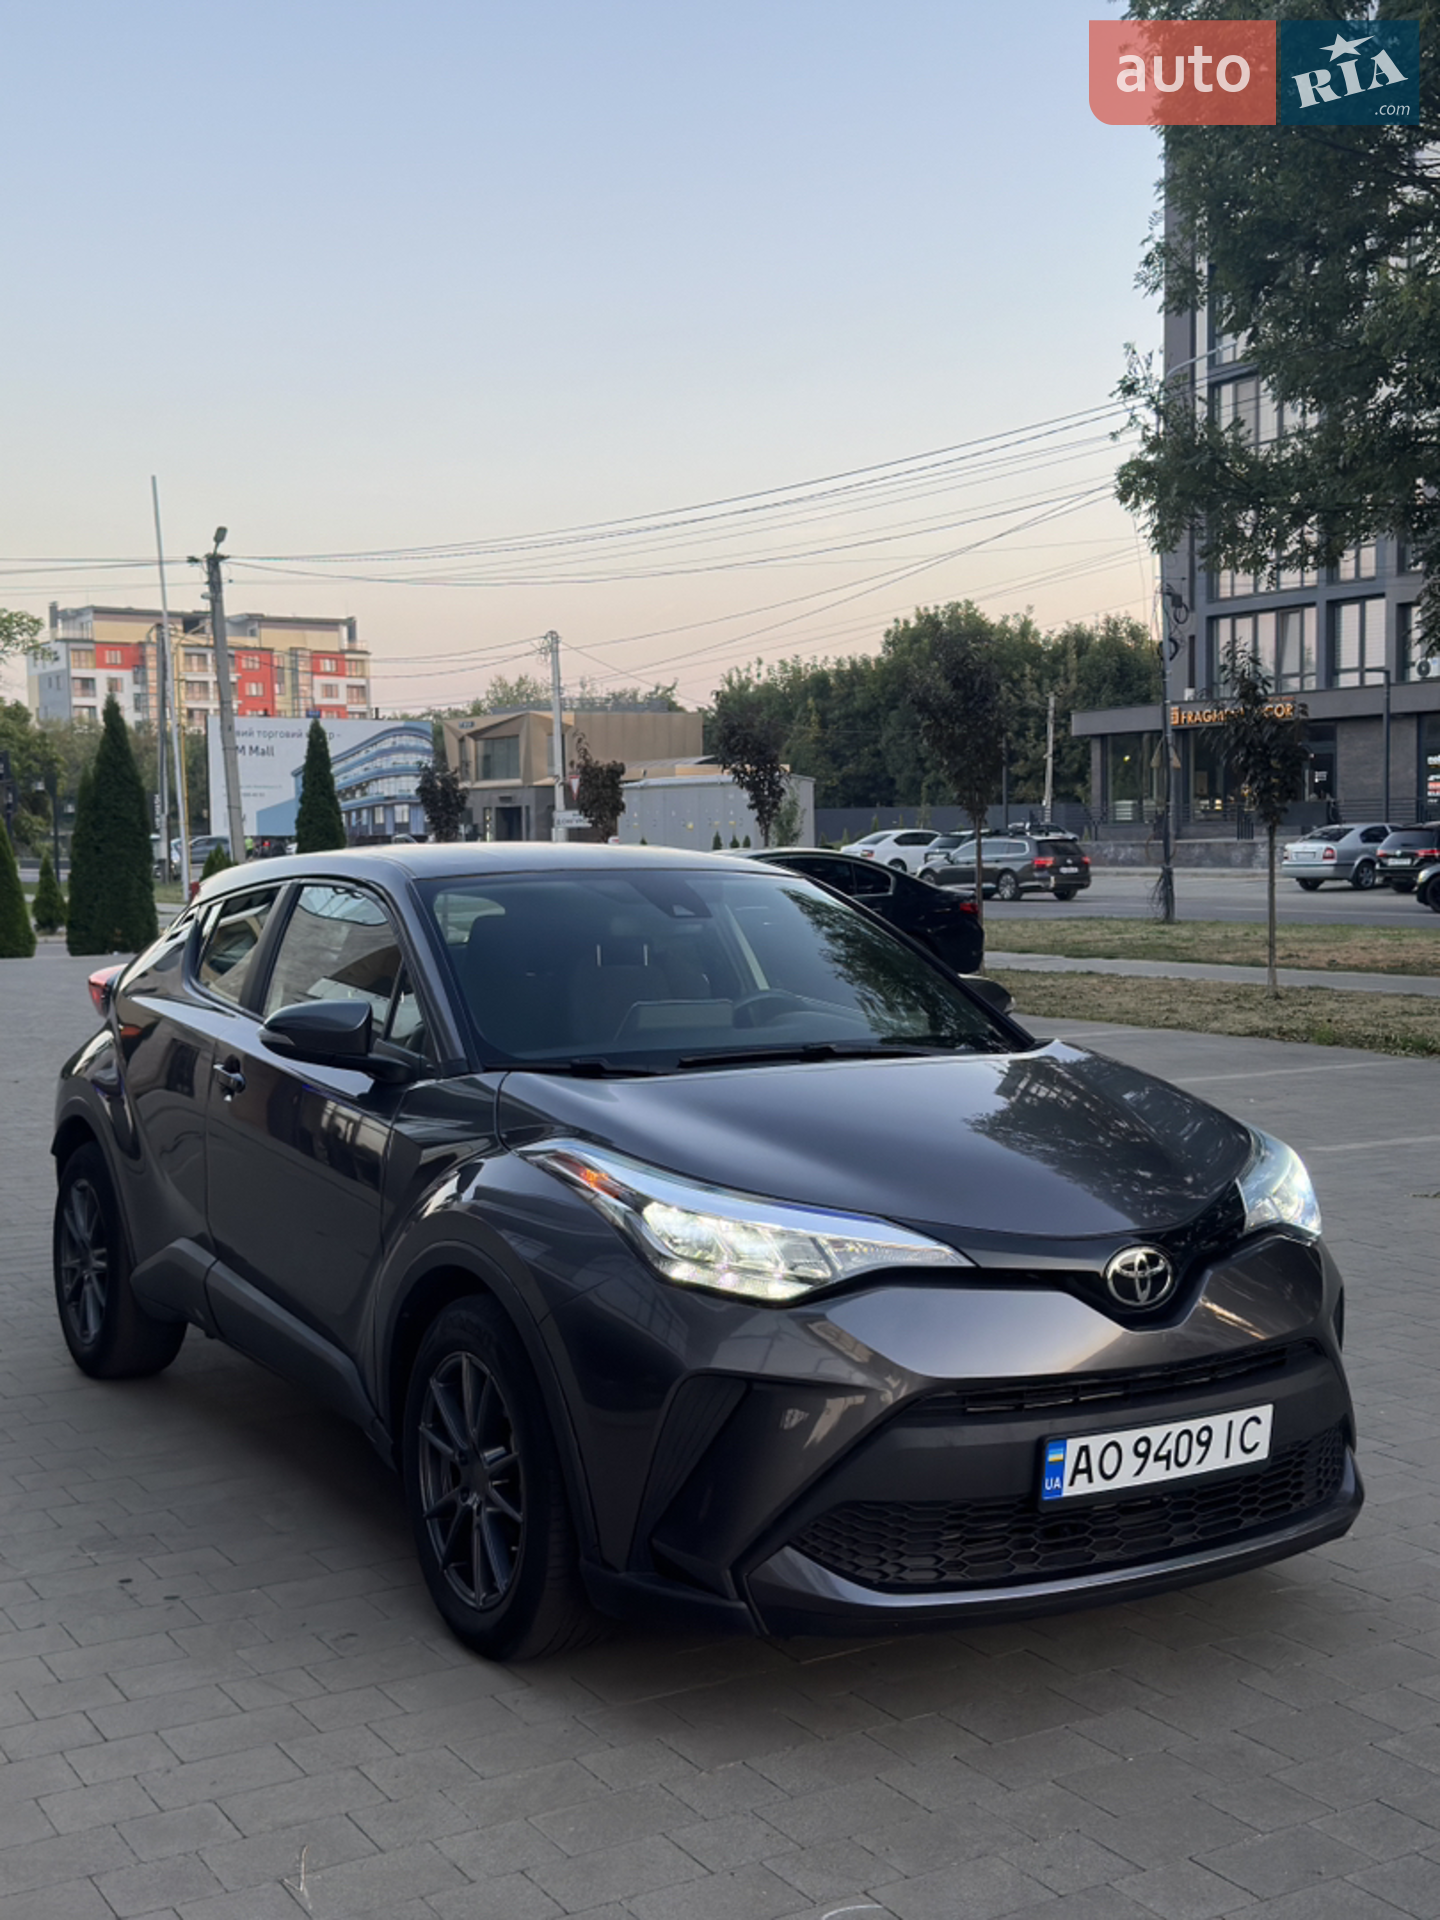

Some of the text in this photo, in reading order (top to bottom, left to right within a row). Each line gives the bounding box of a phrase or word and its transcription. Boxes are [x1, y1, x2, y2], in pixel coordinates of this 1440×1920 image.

[248, 745, 275, 757] Mall
[1068, 1415, 1262, 1487] AO 9409 IC
[1045, 1476, 1062, 1491] UA
